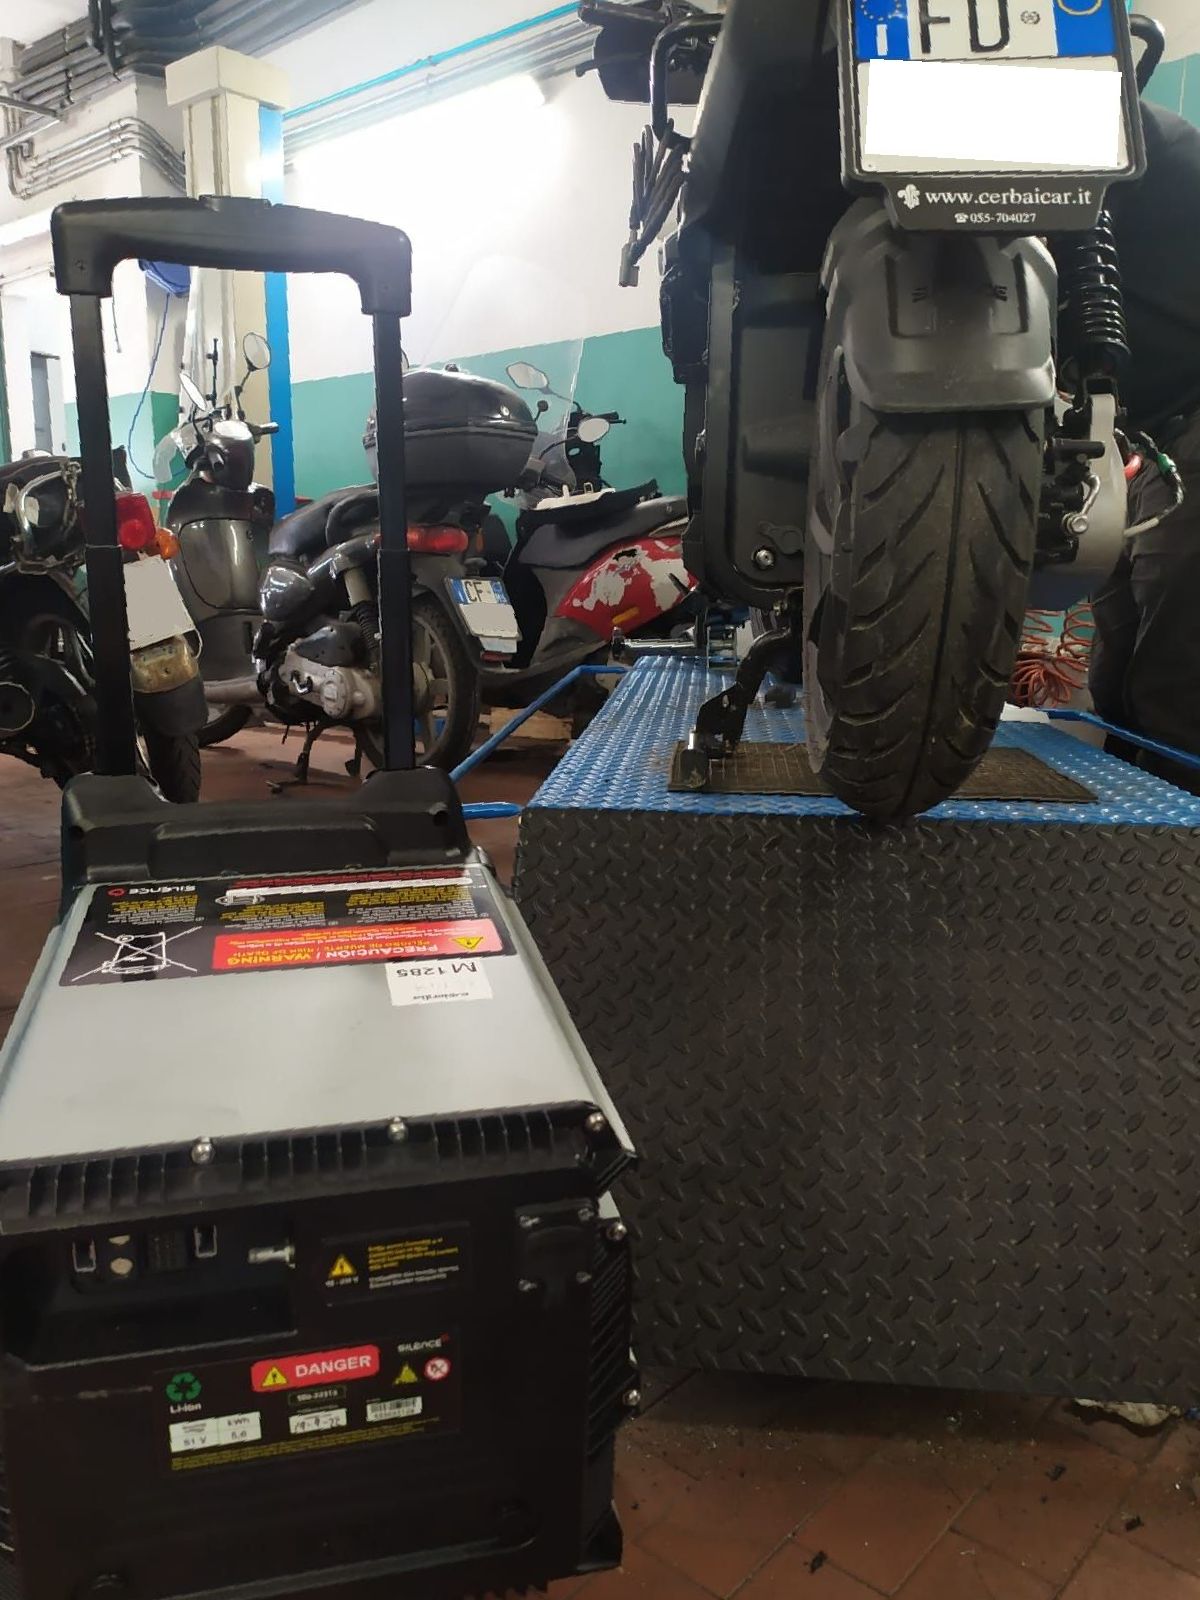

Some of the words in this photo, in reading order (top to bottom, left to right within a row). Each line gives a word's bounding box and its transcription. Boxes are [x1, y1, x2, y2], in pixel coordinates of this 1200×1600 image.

[924, 187, 1092, 205] www.cerbaicar.it
[969, 212, 1037, 224] 055-704027
[227, 952, 312, 966] WARNING
[295, 1354, 372, 1378] DANGER
